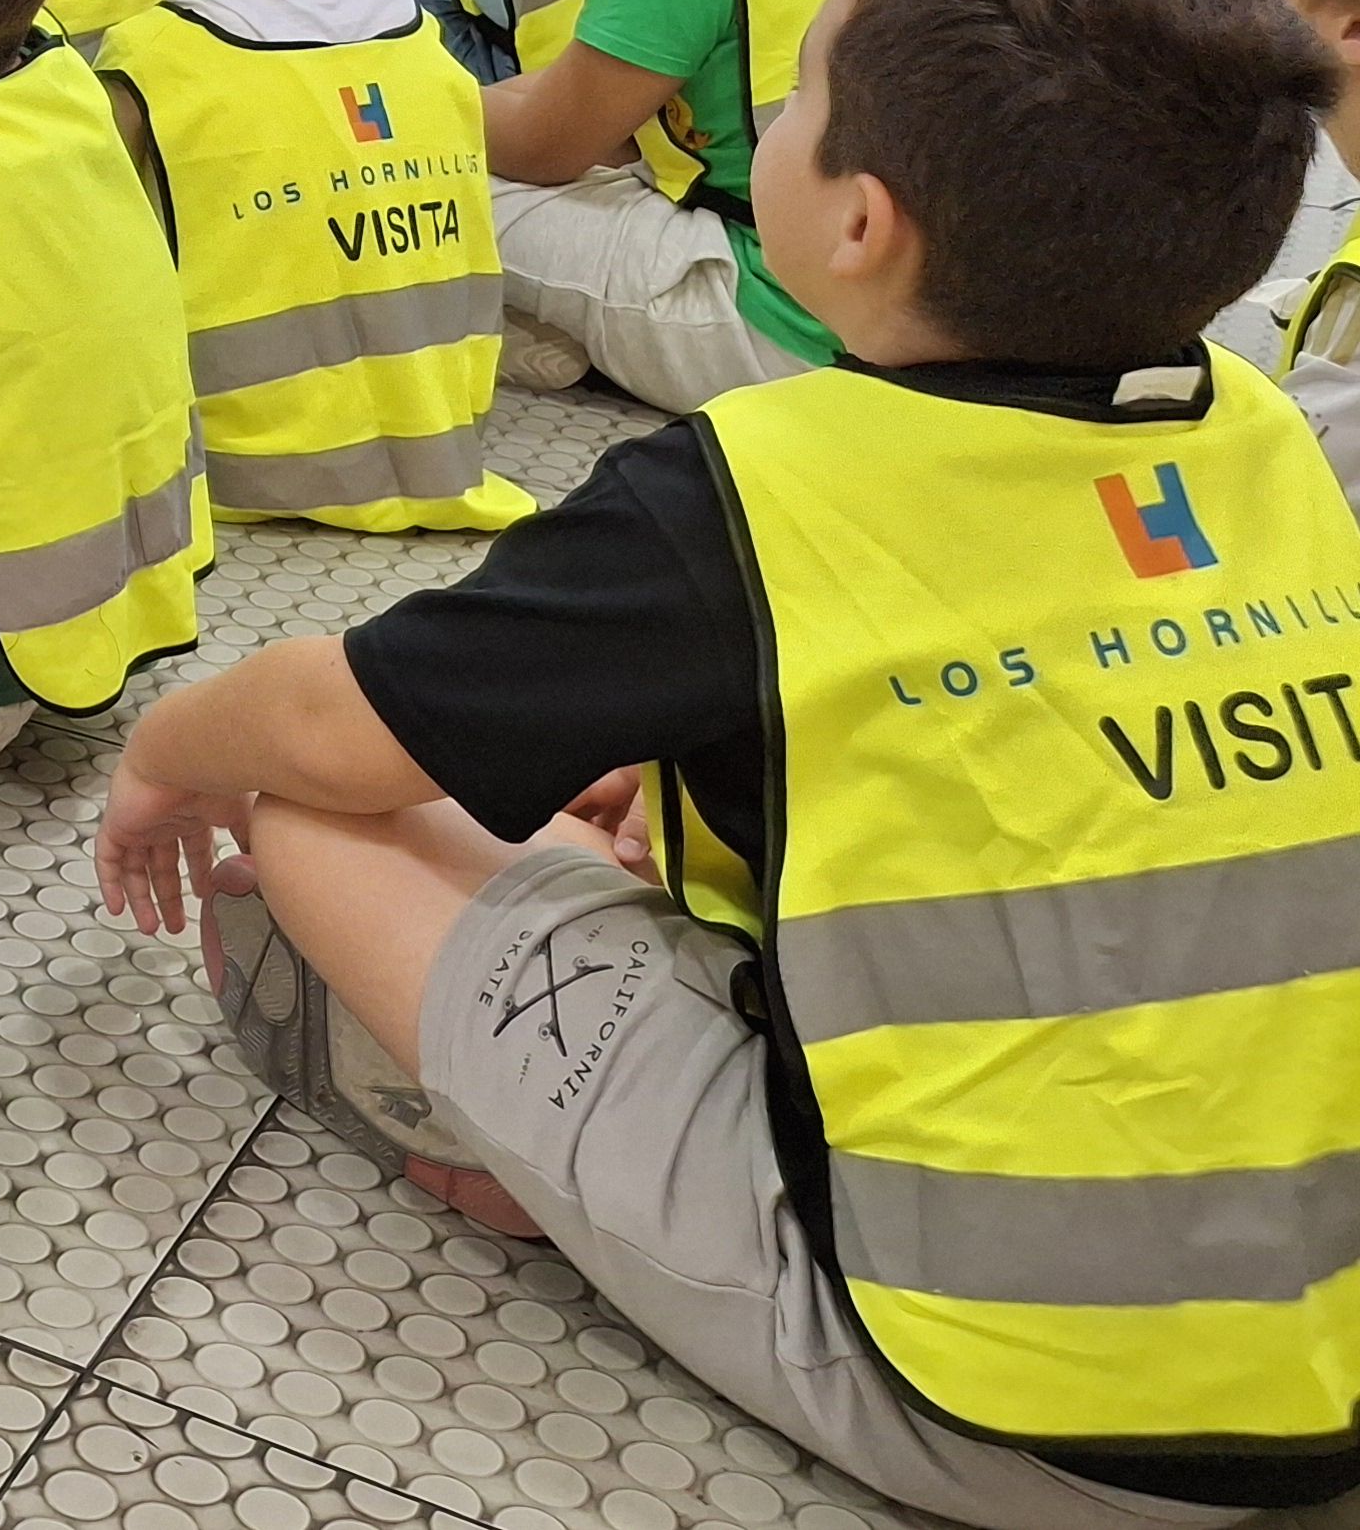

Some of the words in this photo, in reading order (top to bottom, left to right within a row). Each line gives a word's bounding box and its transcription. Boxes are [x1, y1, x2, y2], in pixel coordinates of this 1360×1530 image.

[233, 182, 301, 220] LOS
[328, 199, 460, 261] VISITA
[889, 647, 1035, 707] LOS
[1088, 581, 1360, 669] HORNILL
[1098, 673, 1360, 801] VISIT
[548, 940, 650, 1110] CALIFORNIA
